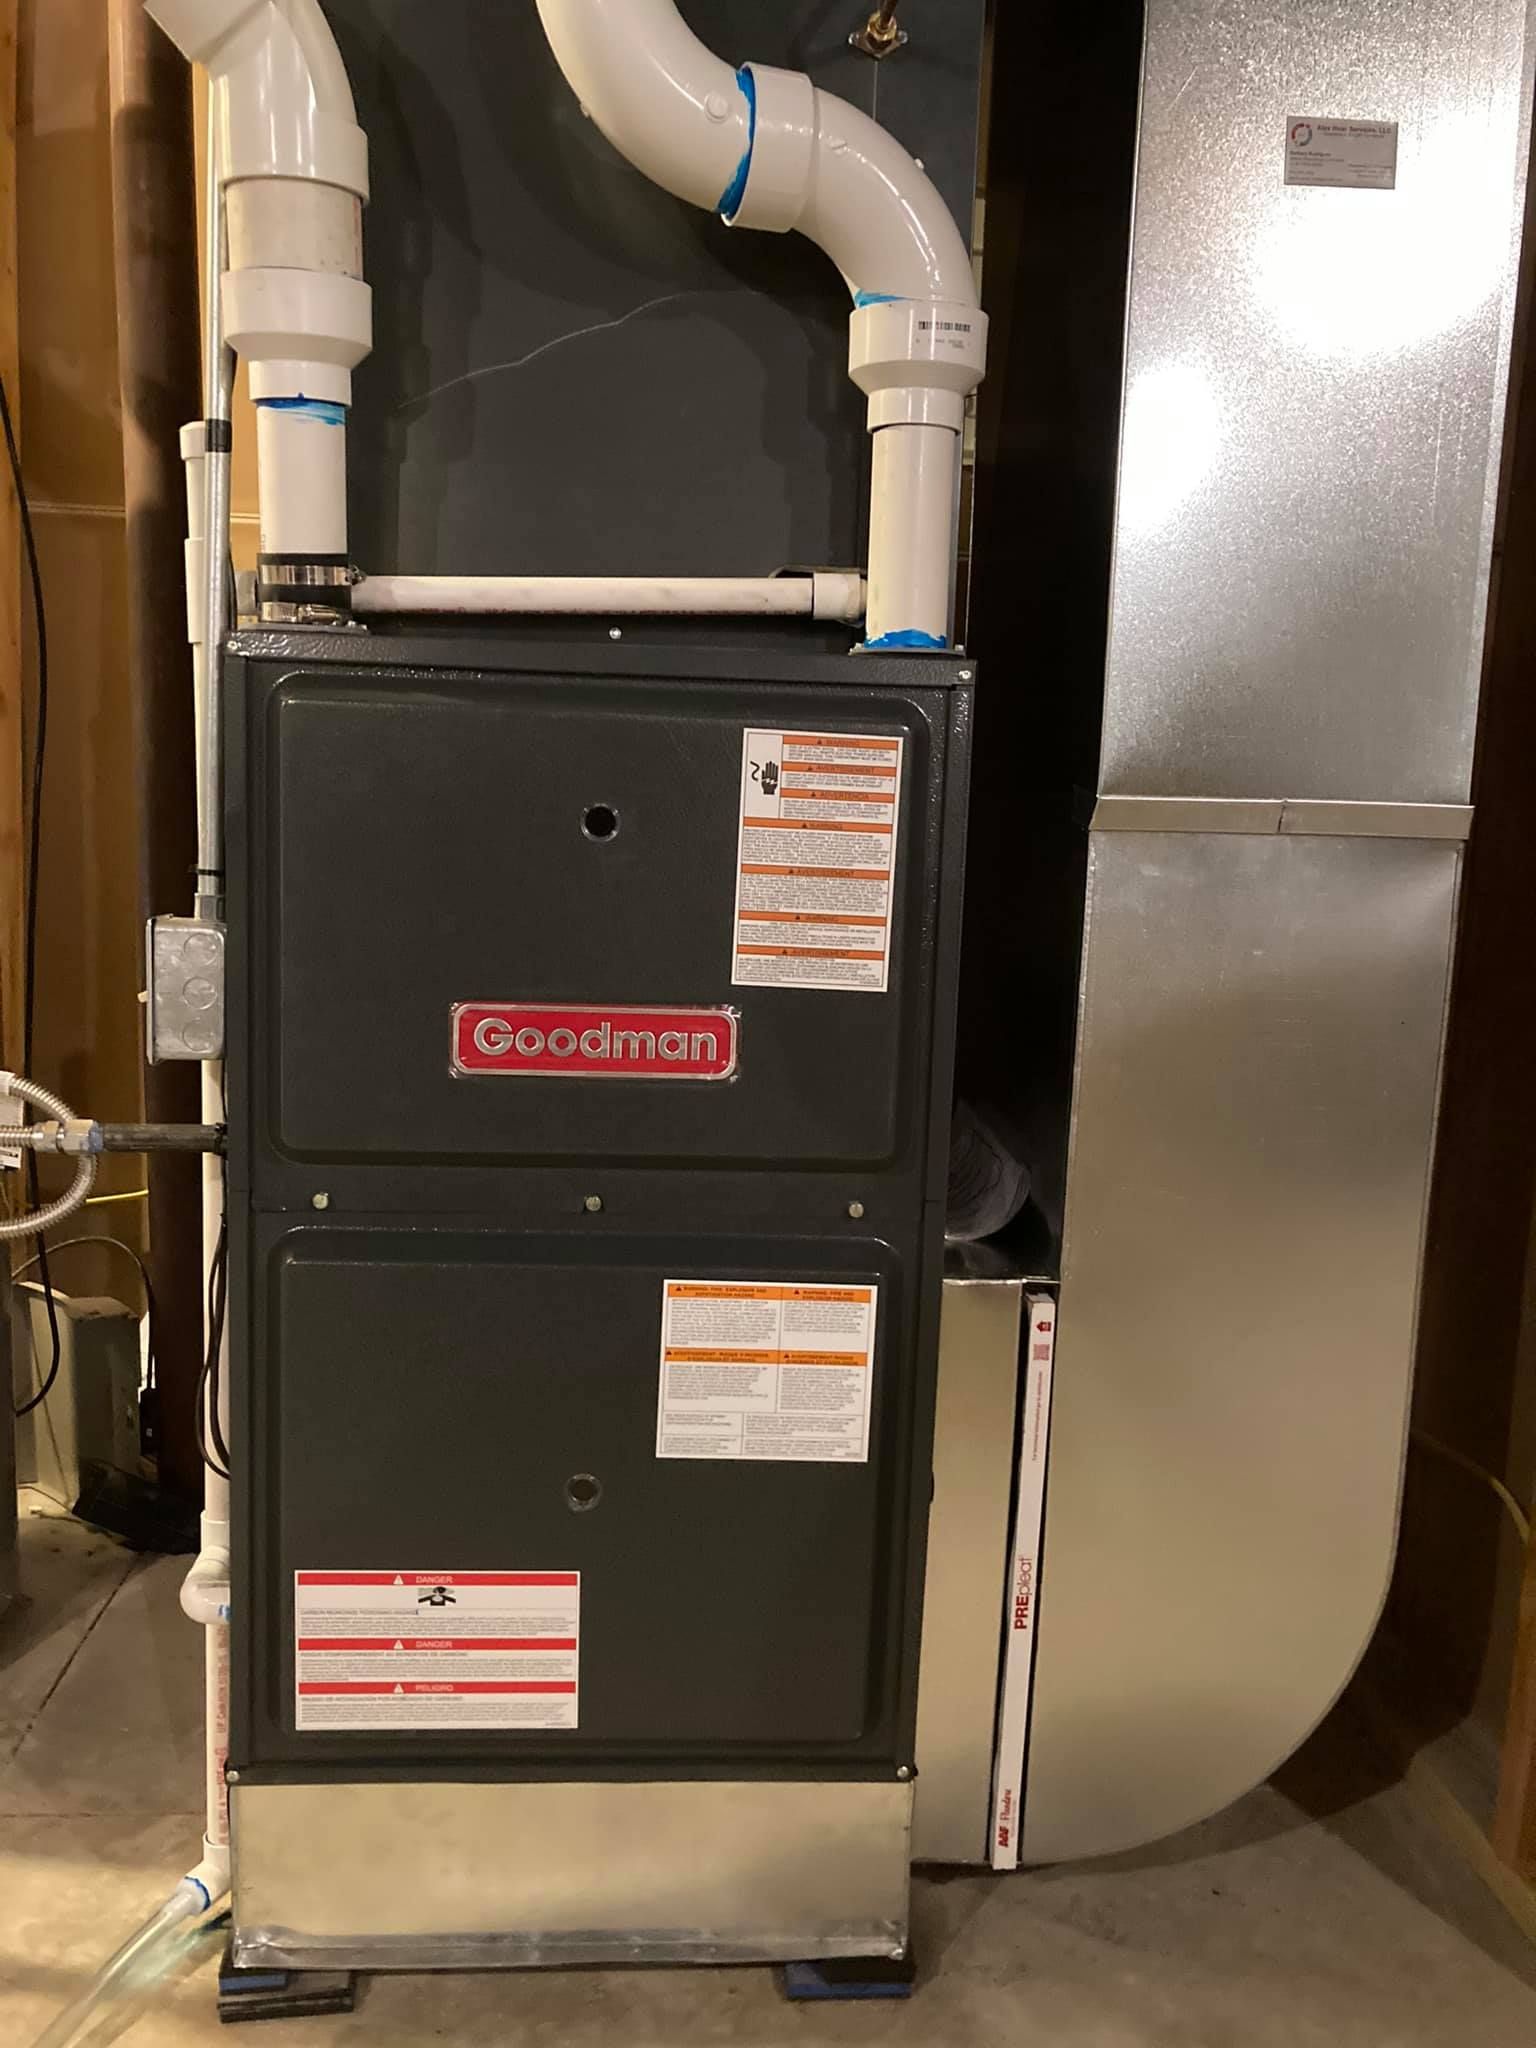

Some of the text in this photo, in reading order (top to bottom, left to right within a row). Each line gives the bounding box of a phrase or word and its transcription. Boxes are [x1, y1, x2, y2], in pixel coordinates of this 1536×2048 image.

[474, 1017, 717, 1061] Goodman
[415, 1575, 453, 1584] DANGER
[1014, 1556, 1033, 1630] PREpleat
[415, 1640, 453, 1649] DANGER
[415, 1684, 454, 1692] PELIGRO
